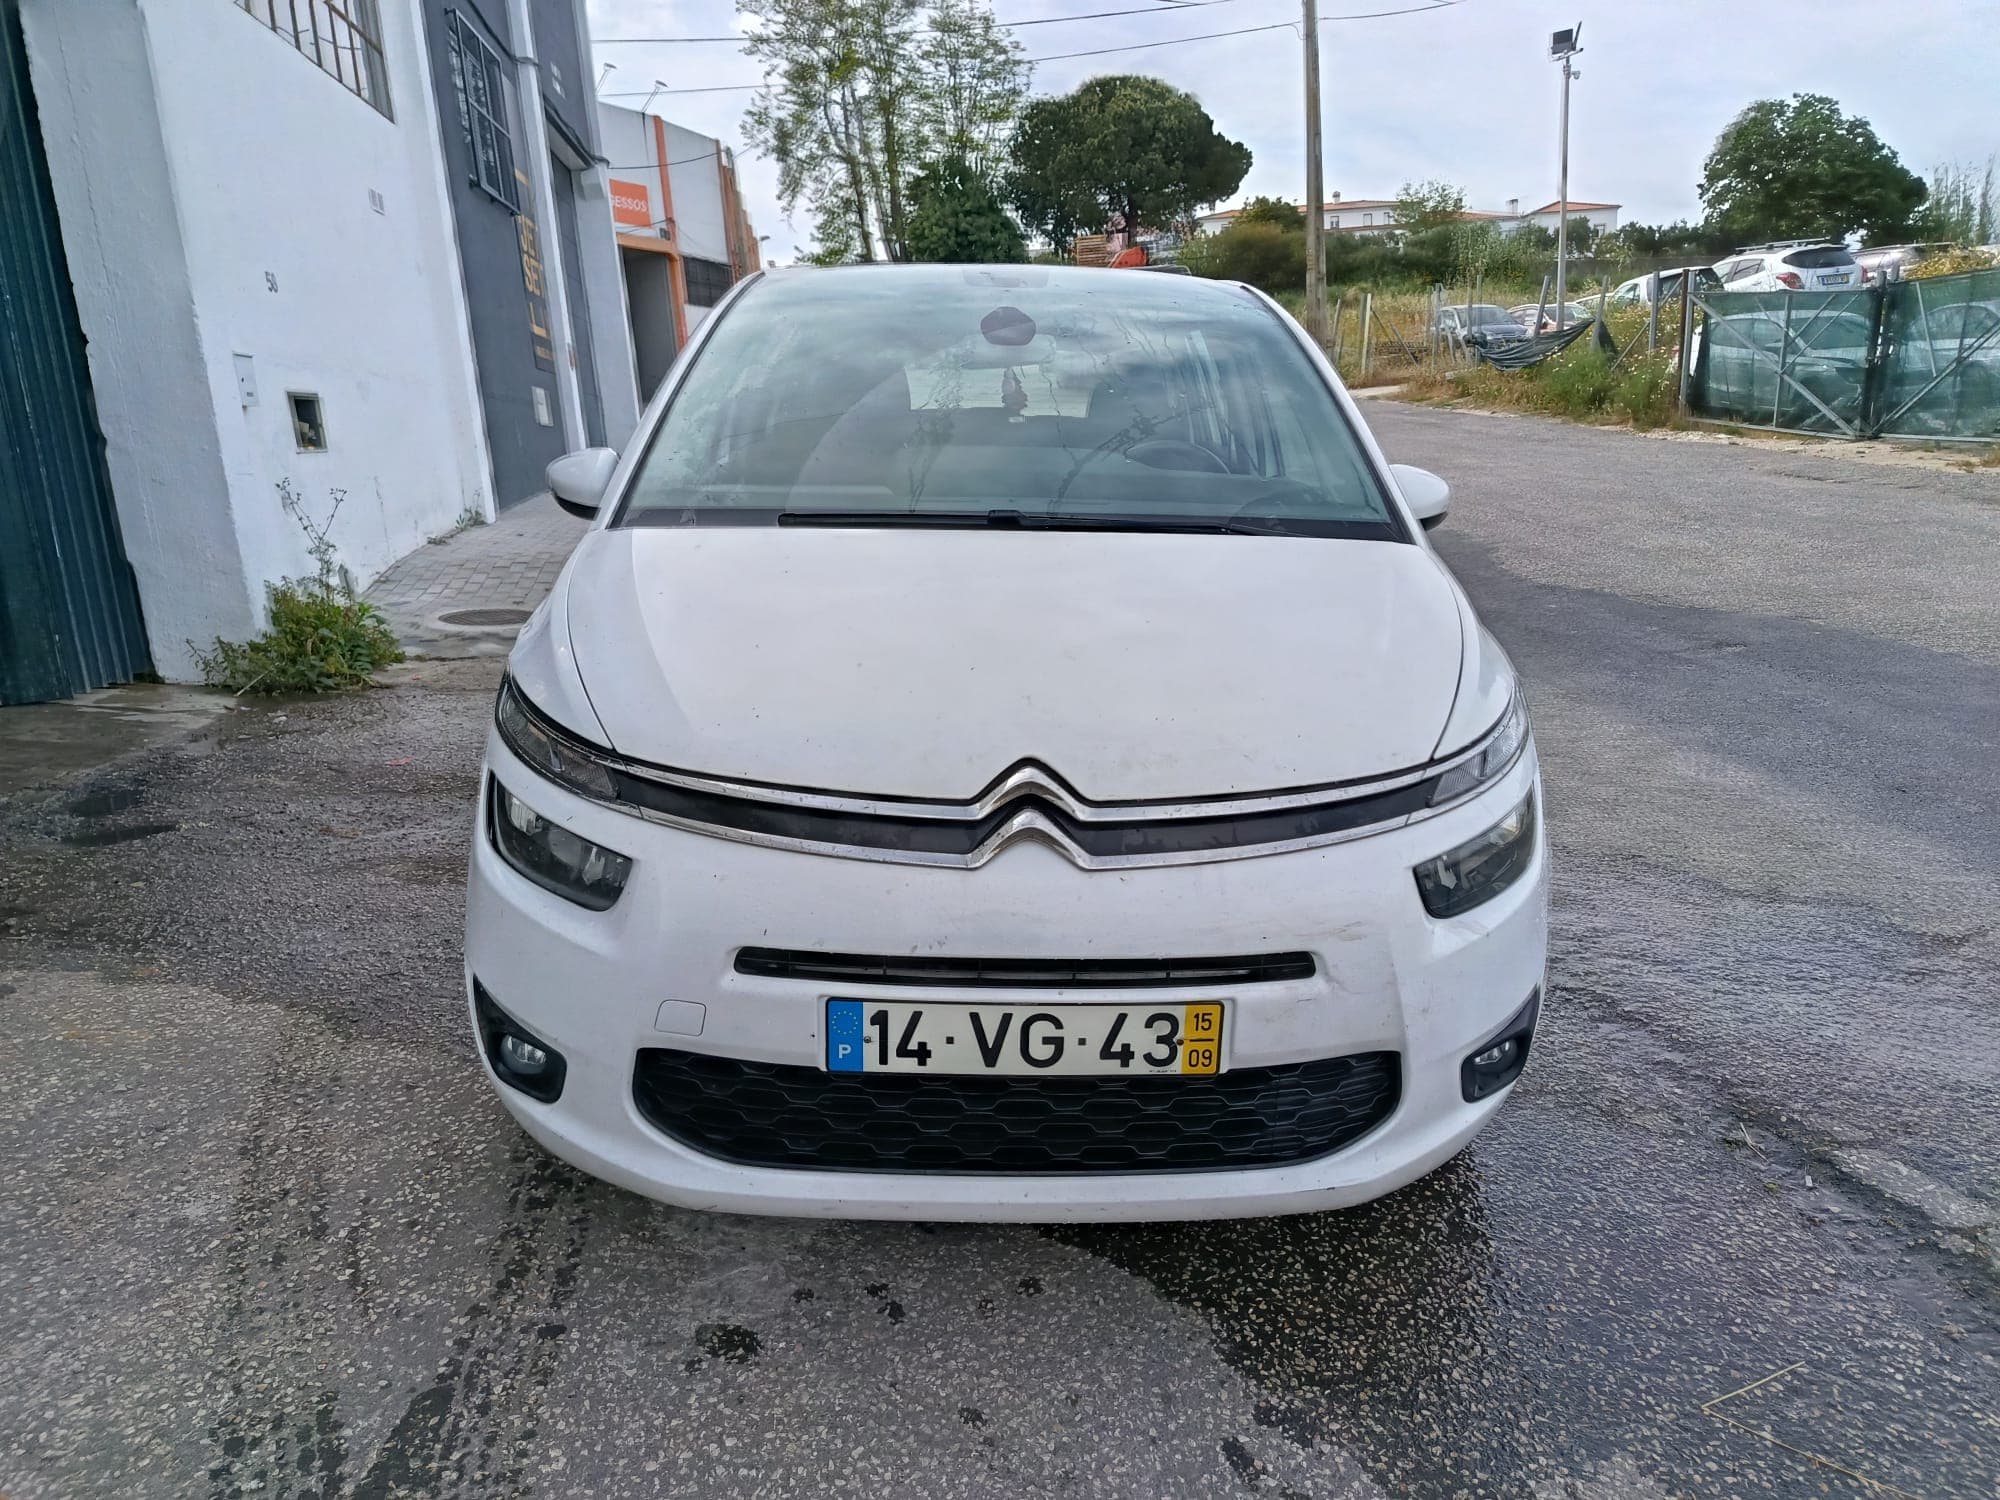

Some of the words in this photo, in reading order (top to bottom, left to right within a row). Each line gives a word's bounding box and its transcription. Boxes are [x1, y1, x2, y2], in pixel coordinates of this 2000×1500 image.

[1194, 1012, 1213, 1031] 15
[838, 1044, 852, 1059] P
[1188, 1049, 1213, 1067] 09
